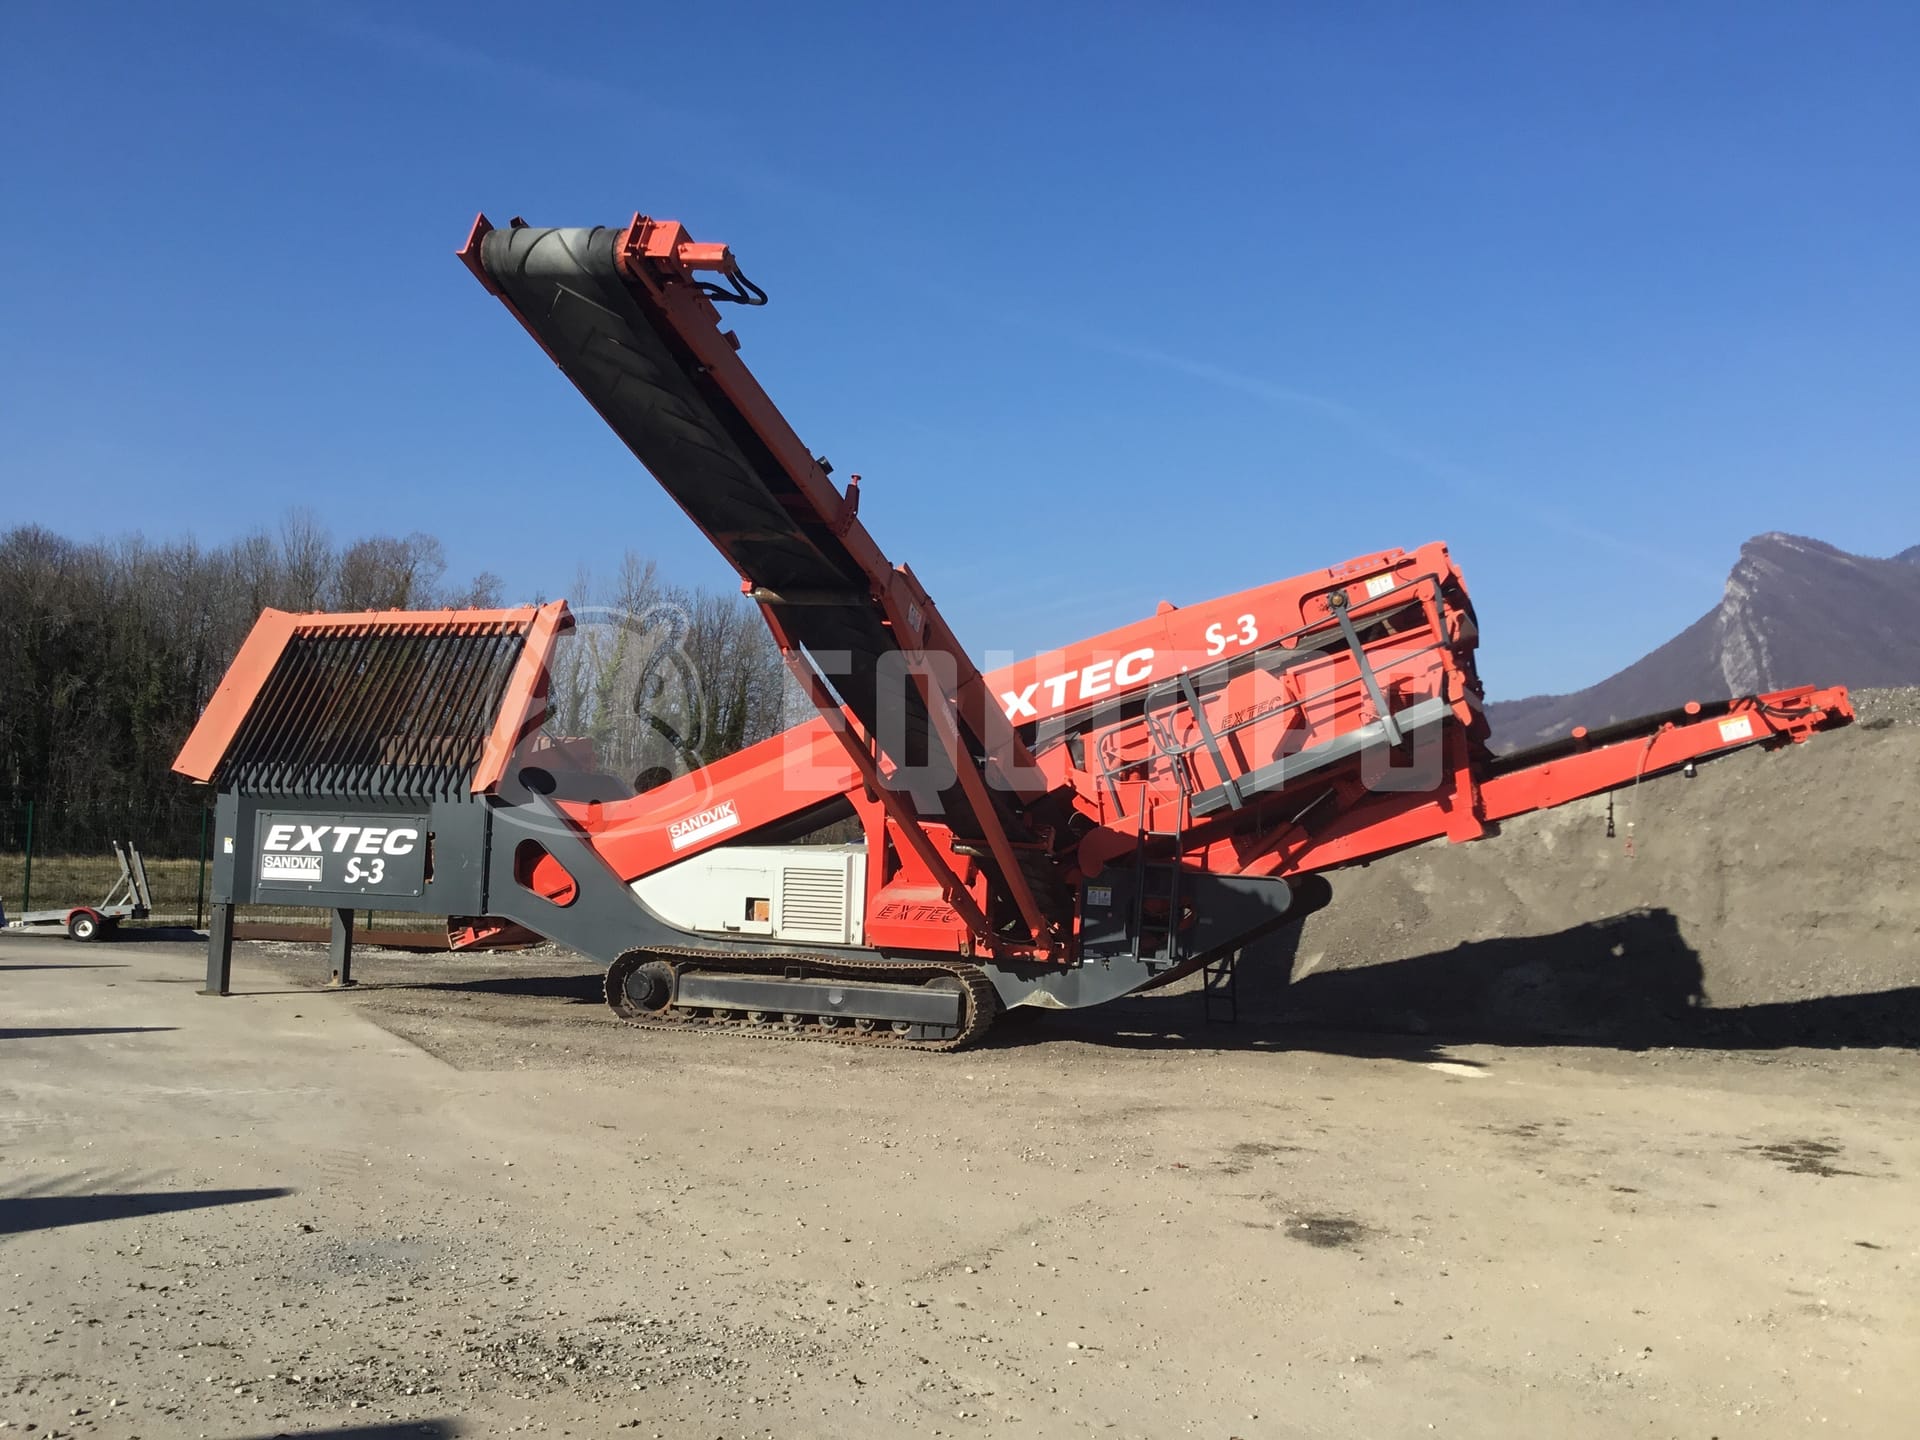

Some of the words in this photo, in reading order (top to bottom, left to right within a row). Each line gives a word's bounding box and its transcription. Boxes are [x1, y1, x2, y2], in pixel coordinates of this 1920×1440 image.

[1000, 647, 1155, 721] XTEC
[1205, 613, 1259, 657] S-3
[669, 801, 735, 838] SANDVIK
[263, 824, 419, 856] EXTEC
[263, 855, 321, 870] SANDVIK
[344, 856, 386, 885] S-3
[874, 903, 959, 924] EXTEC
